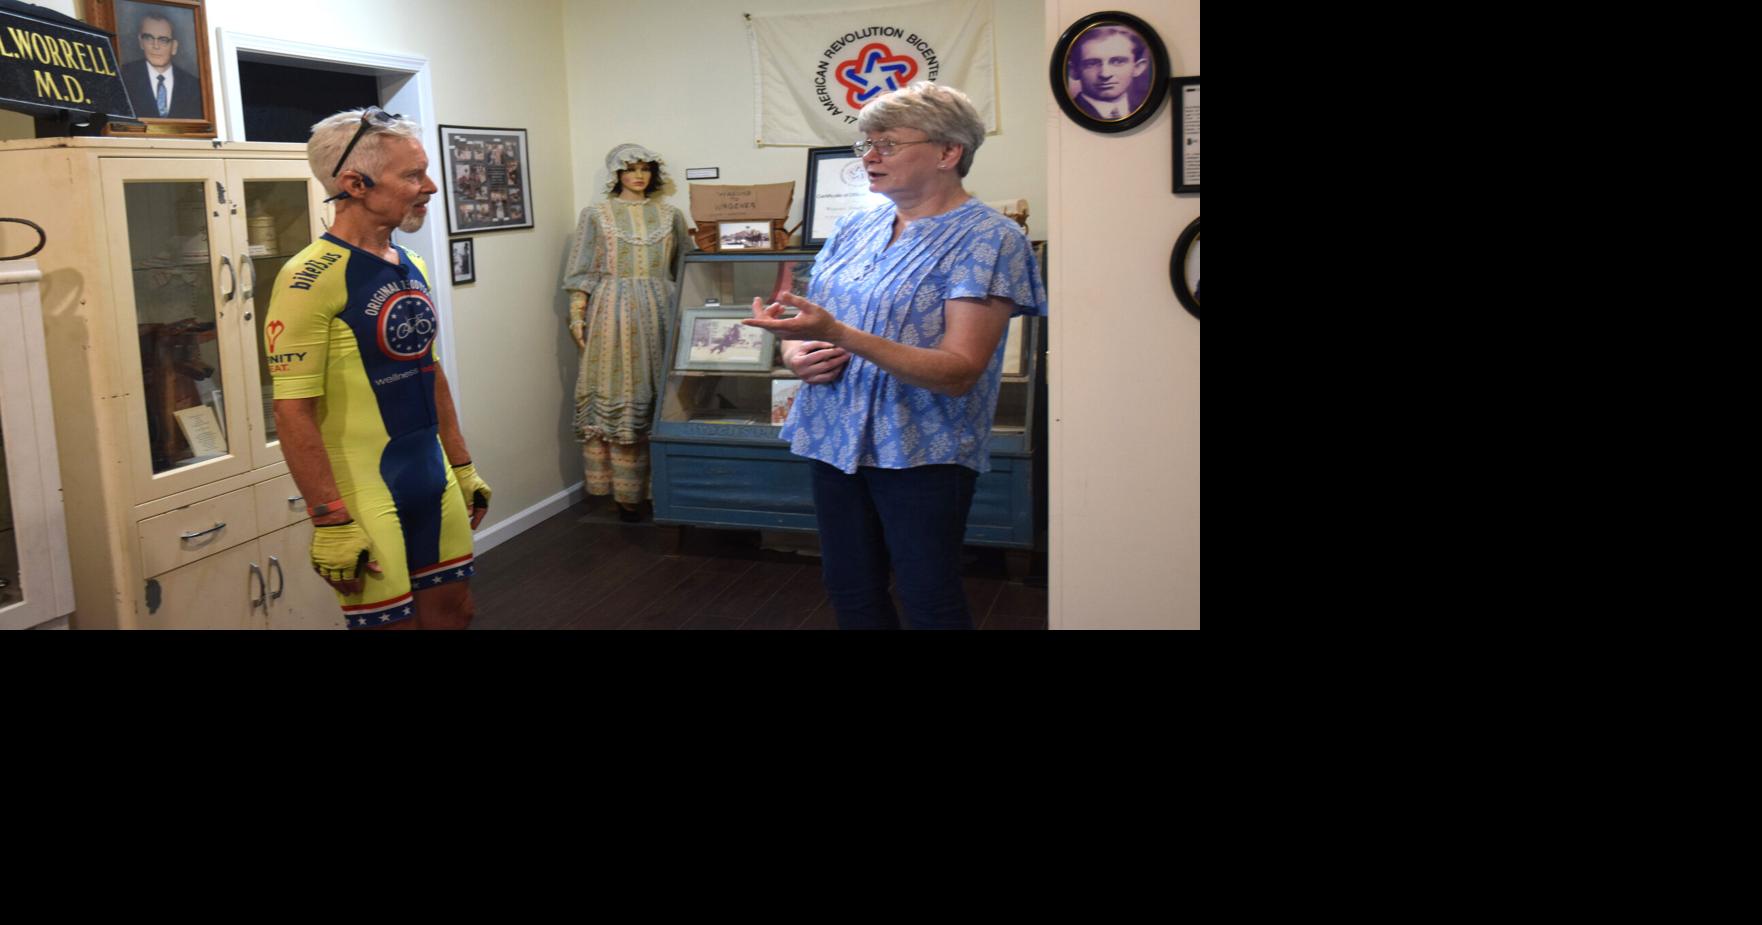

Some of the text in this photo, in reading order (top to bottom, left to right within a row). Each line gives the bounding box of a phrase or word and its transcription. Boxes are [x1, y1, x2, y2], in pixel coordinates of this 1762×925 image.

[823, 26, 904, 59] REVOLUTION
[33, 69, 92, 104] M.D.
[814, 60, 843, 116] AMERICAN
[364, 281, 400, 316] ORIGINAL
